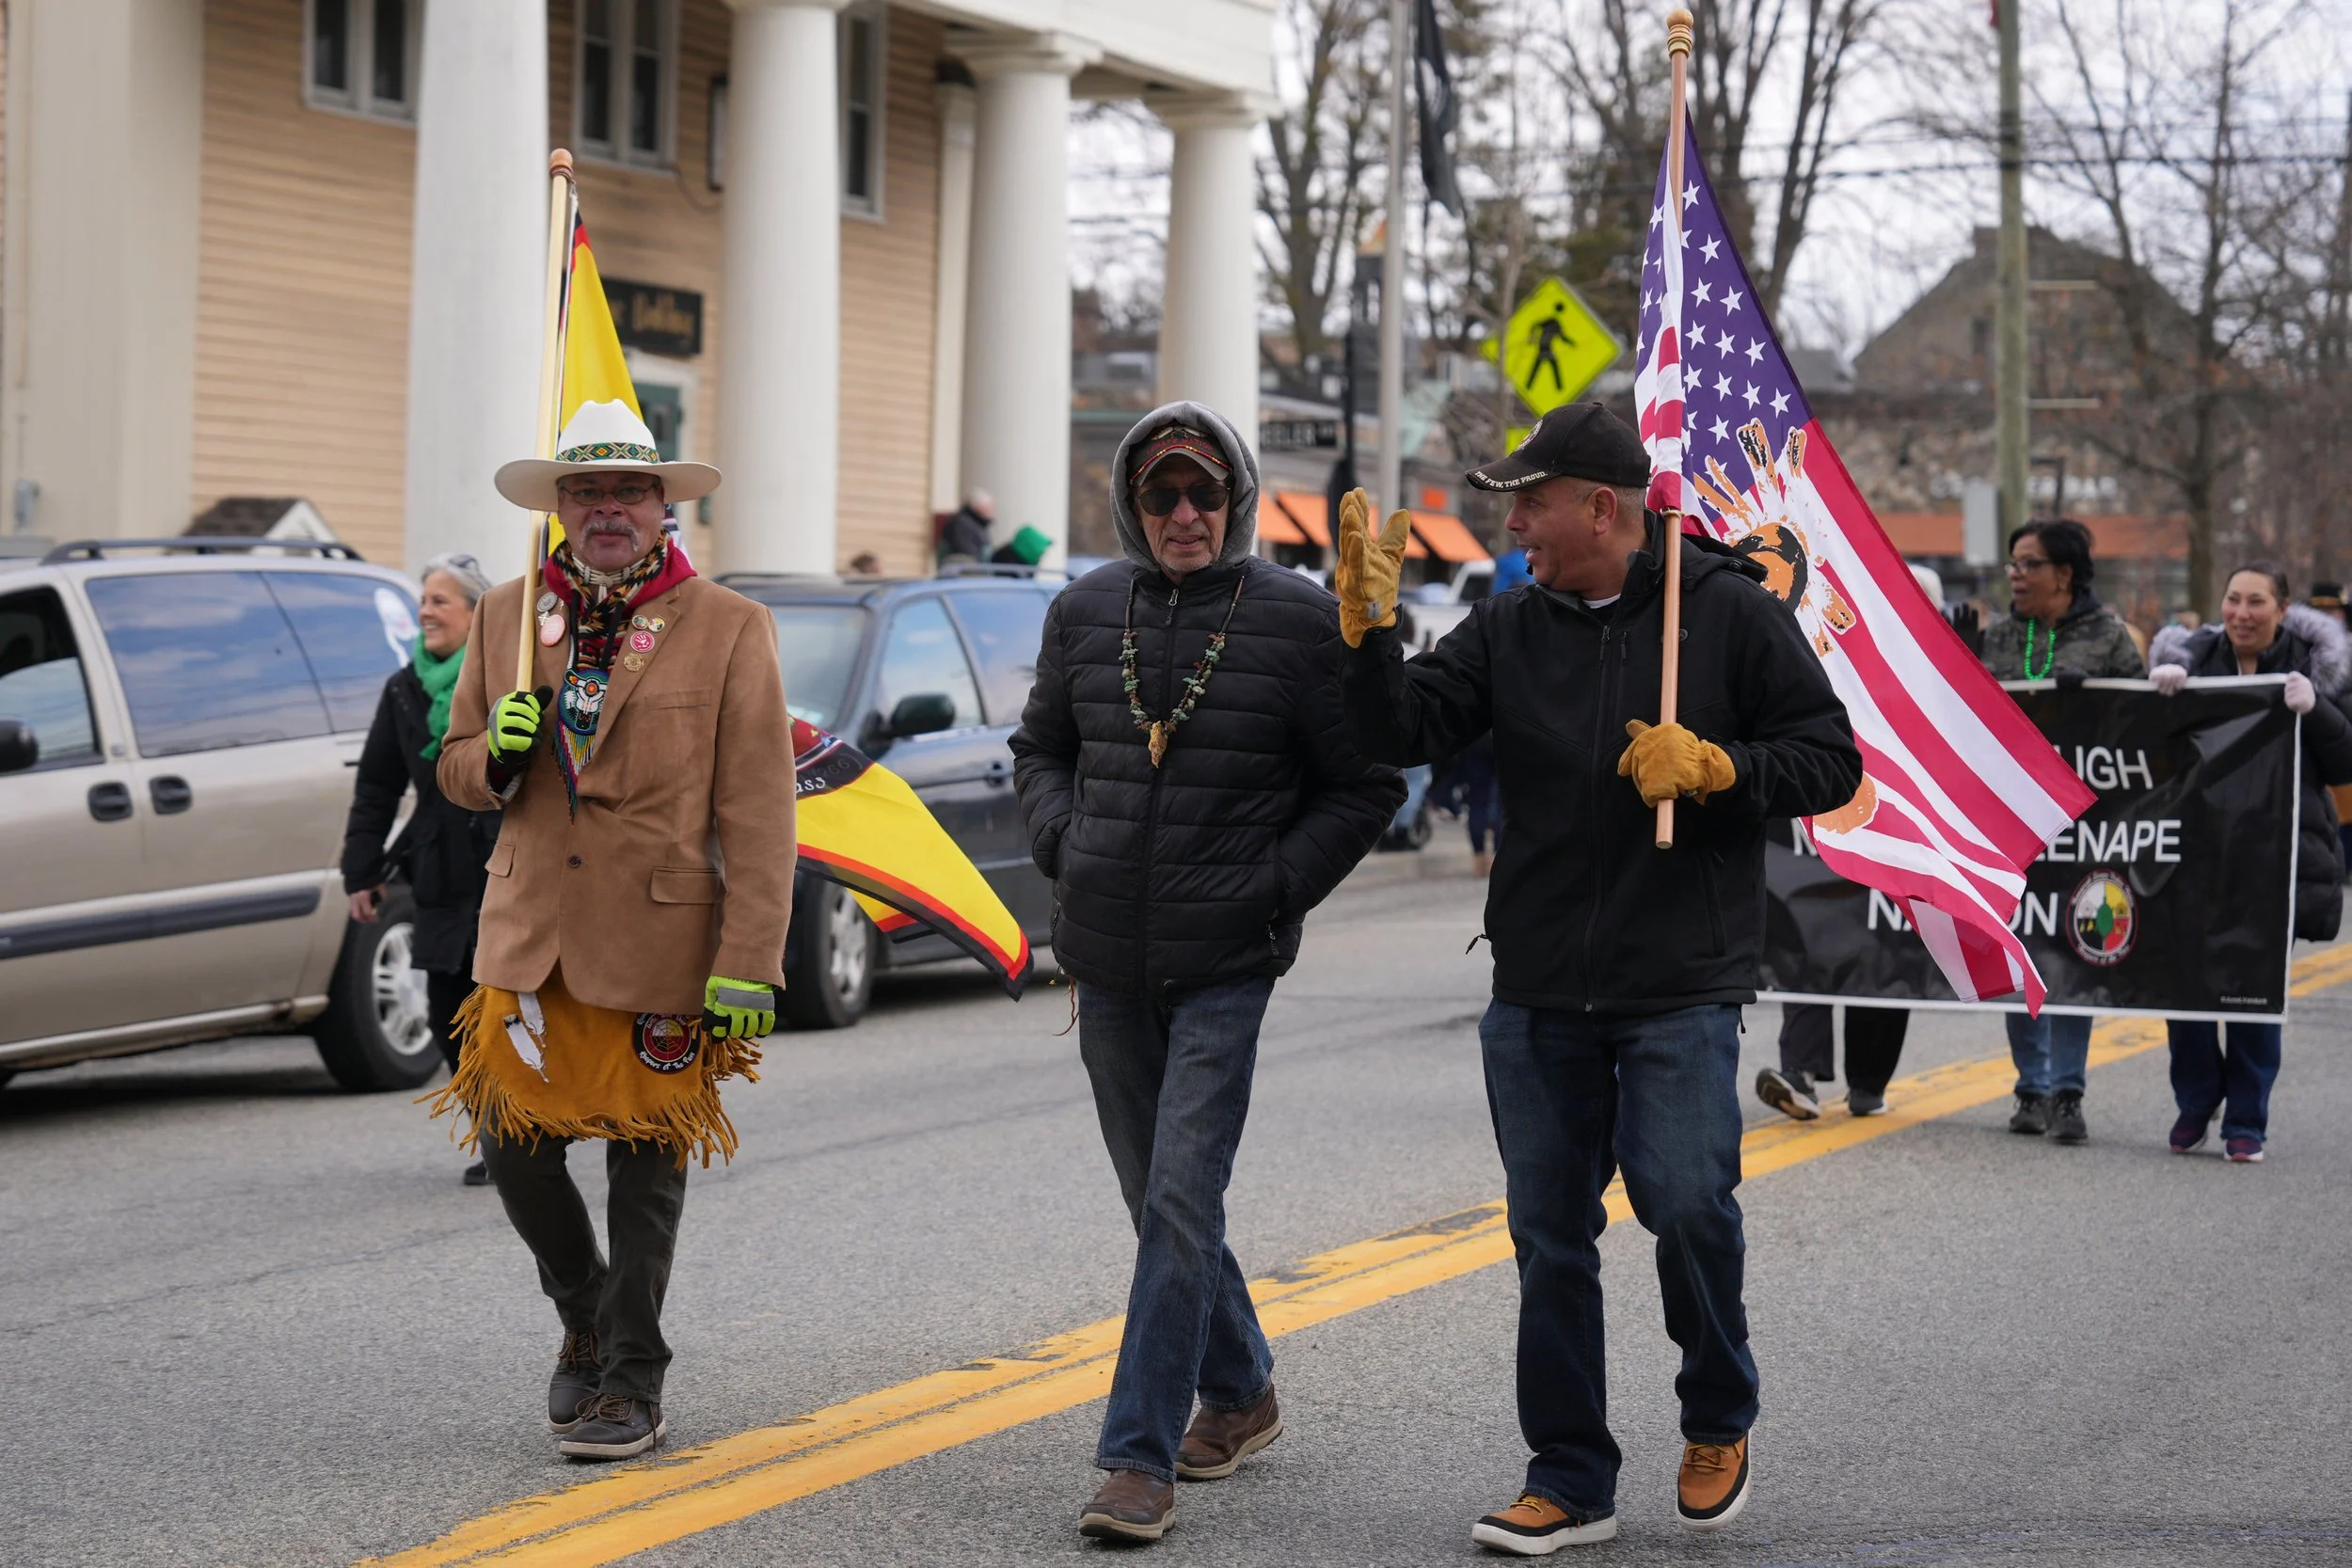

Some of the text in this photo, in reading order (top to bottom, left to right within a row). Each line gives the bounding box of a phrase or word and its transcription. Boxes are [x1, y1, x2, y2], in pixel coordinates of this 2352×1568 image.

[1474, 470, 1488, 482] THE
[1504, 479, 1521, 487] THE
[2034, 819, 2182, 863] ENAPE
